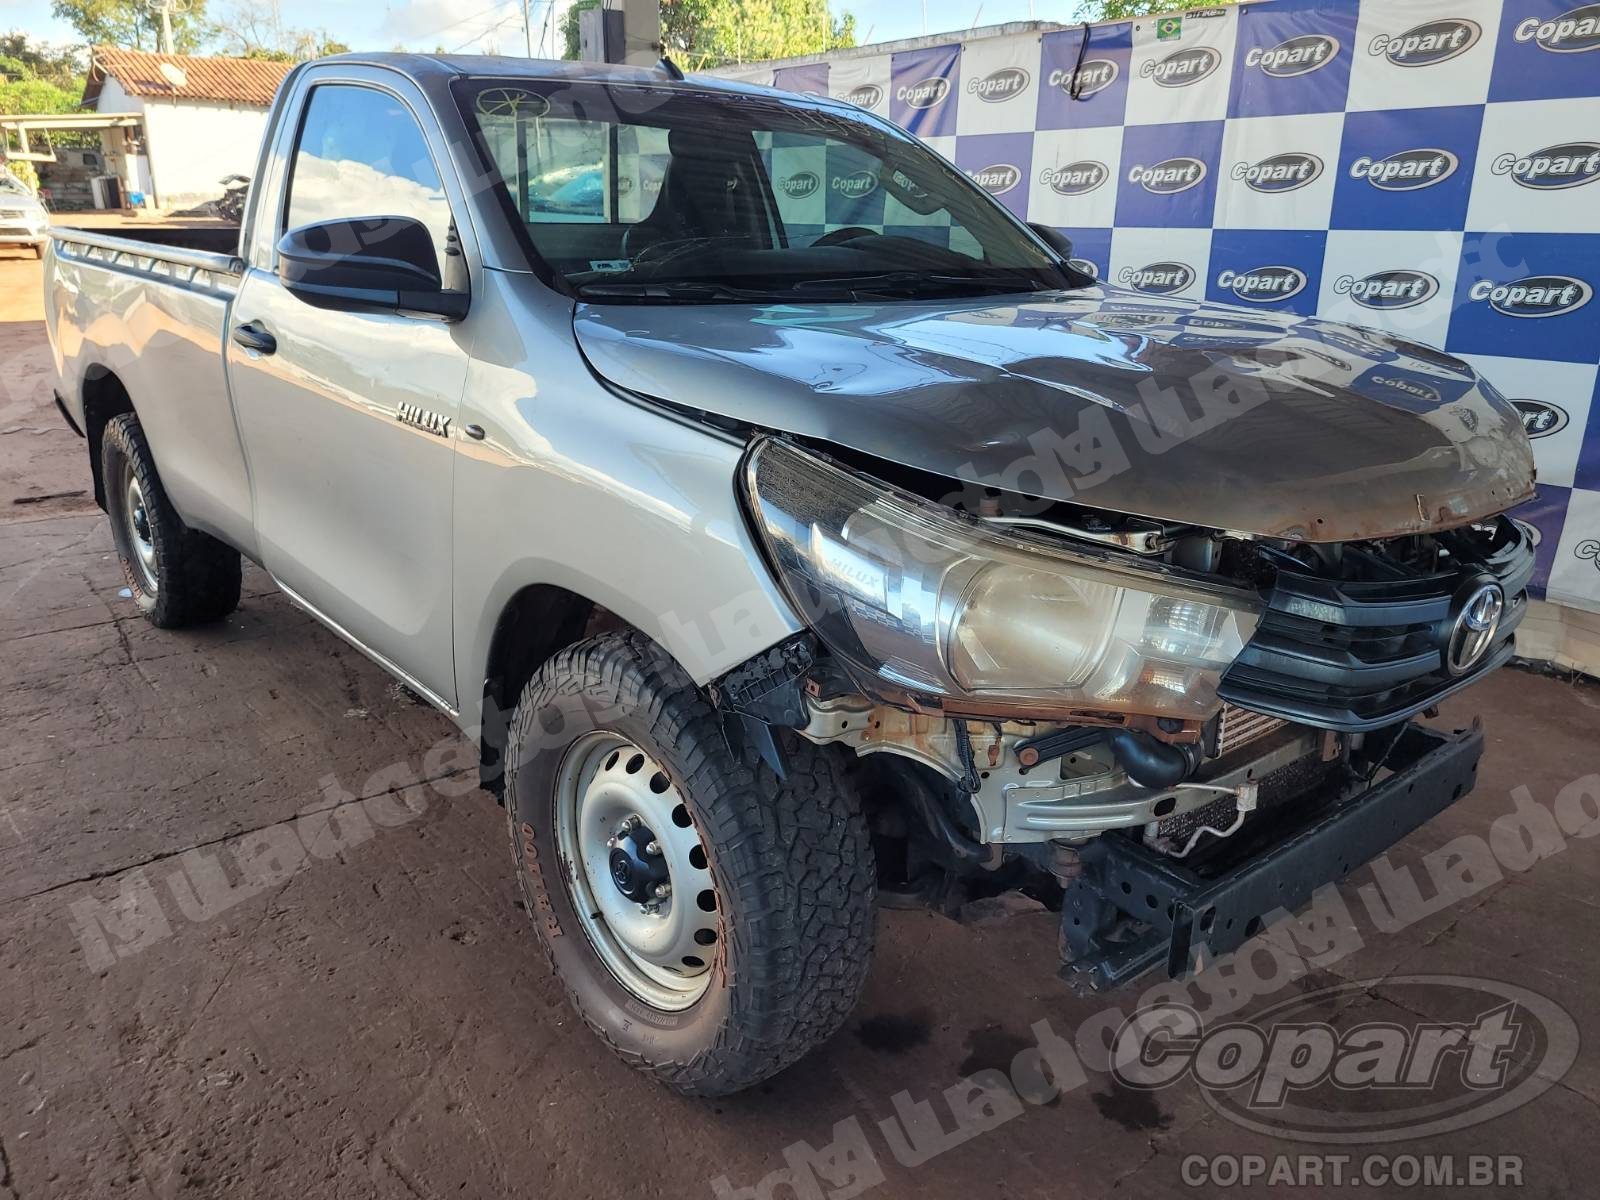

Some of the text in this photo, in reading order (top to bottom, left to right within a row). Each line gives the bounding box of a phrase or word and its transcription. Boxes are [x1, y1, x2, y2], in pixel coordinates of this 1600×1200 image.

[1245, 39, 1327, 74] Copart
[1368, 27, 1466, 61] Copart
[1049, 64, 1110, 88] Copart
[1140, 54, 1209, 80] Copart
[896, 84, 945, 102] Copart
[967, 75, 1020, 95] Copart
[1040, 166, 1099, 187] Copart
[1129, 161, 1197, 188] Copart
[1231, 157, 1313, 187] Copart
[1350, 154, 1446, 187] Copart
[1491, 149, 1600, 181] Copart
[778, 176, 813, 191] Copart
[832, 176, 871, 192] Copart
[1118, 263, 1186, 291] Copart
[1217, 267, 1296, 296] Copart
[1333, 273, 1425, 303] Copart
[1469, 278, 1577, 310] Copart
[396, 401, 451, 438] HILUX
[832, 557, 880, 587] HILUX
